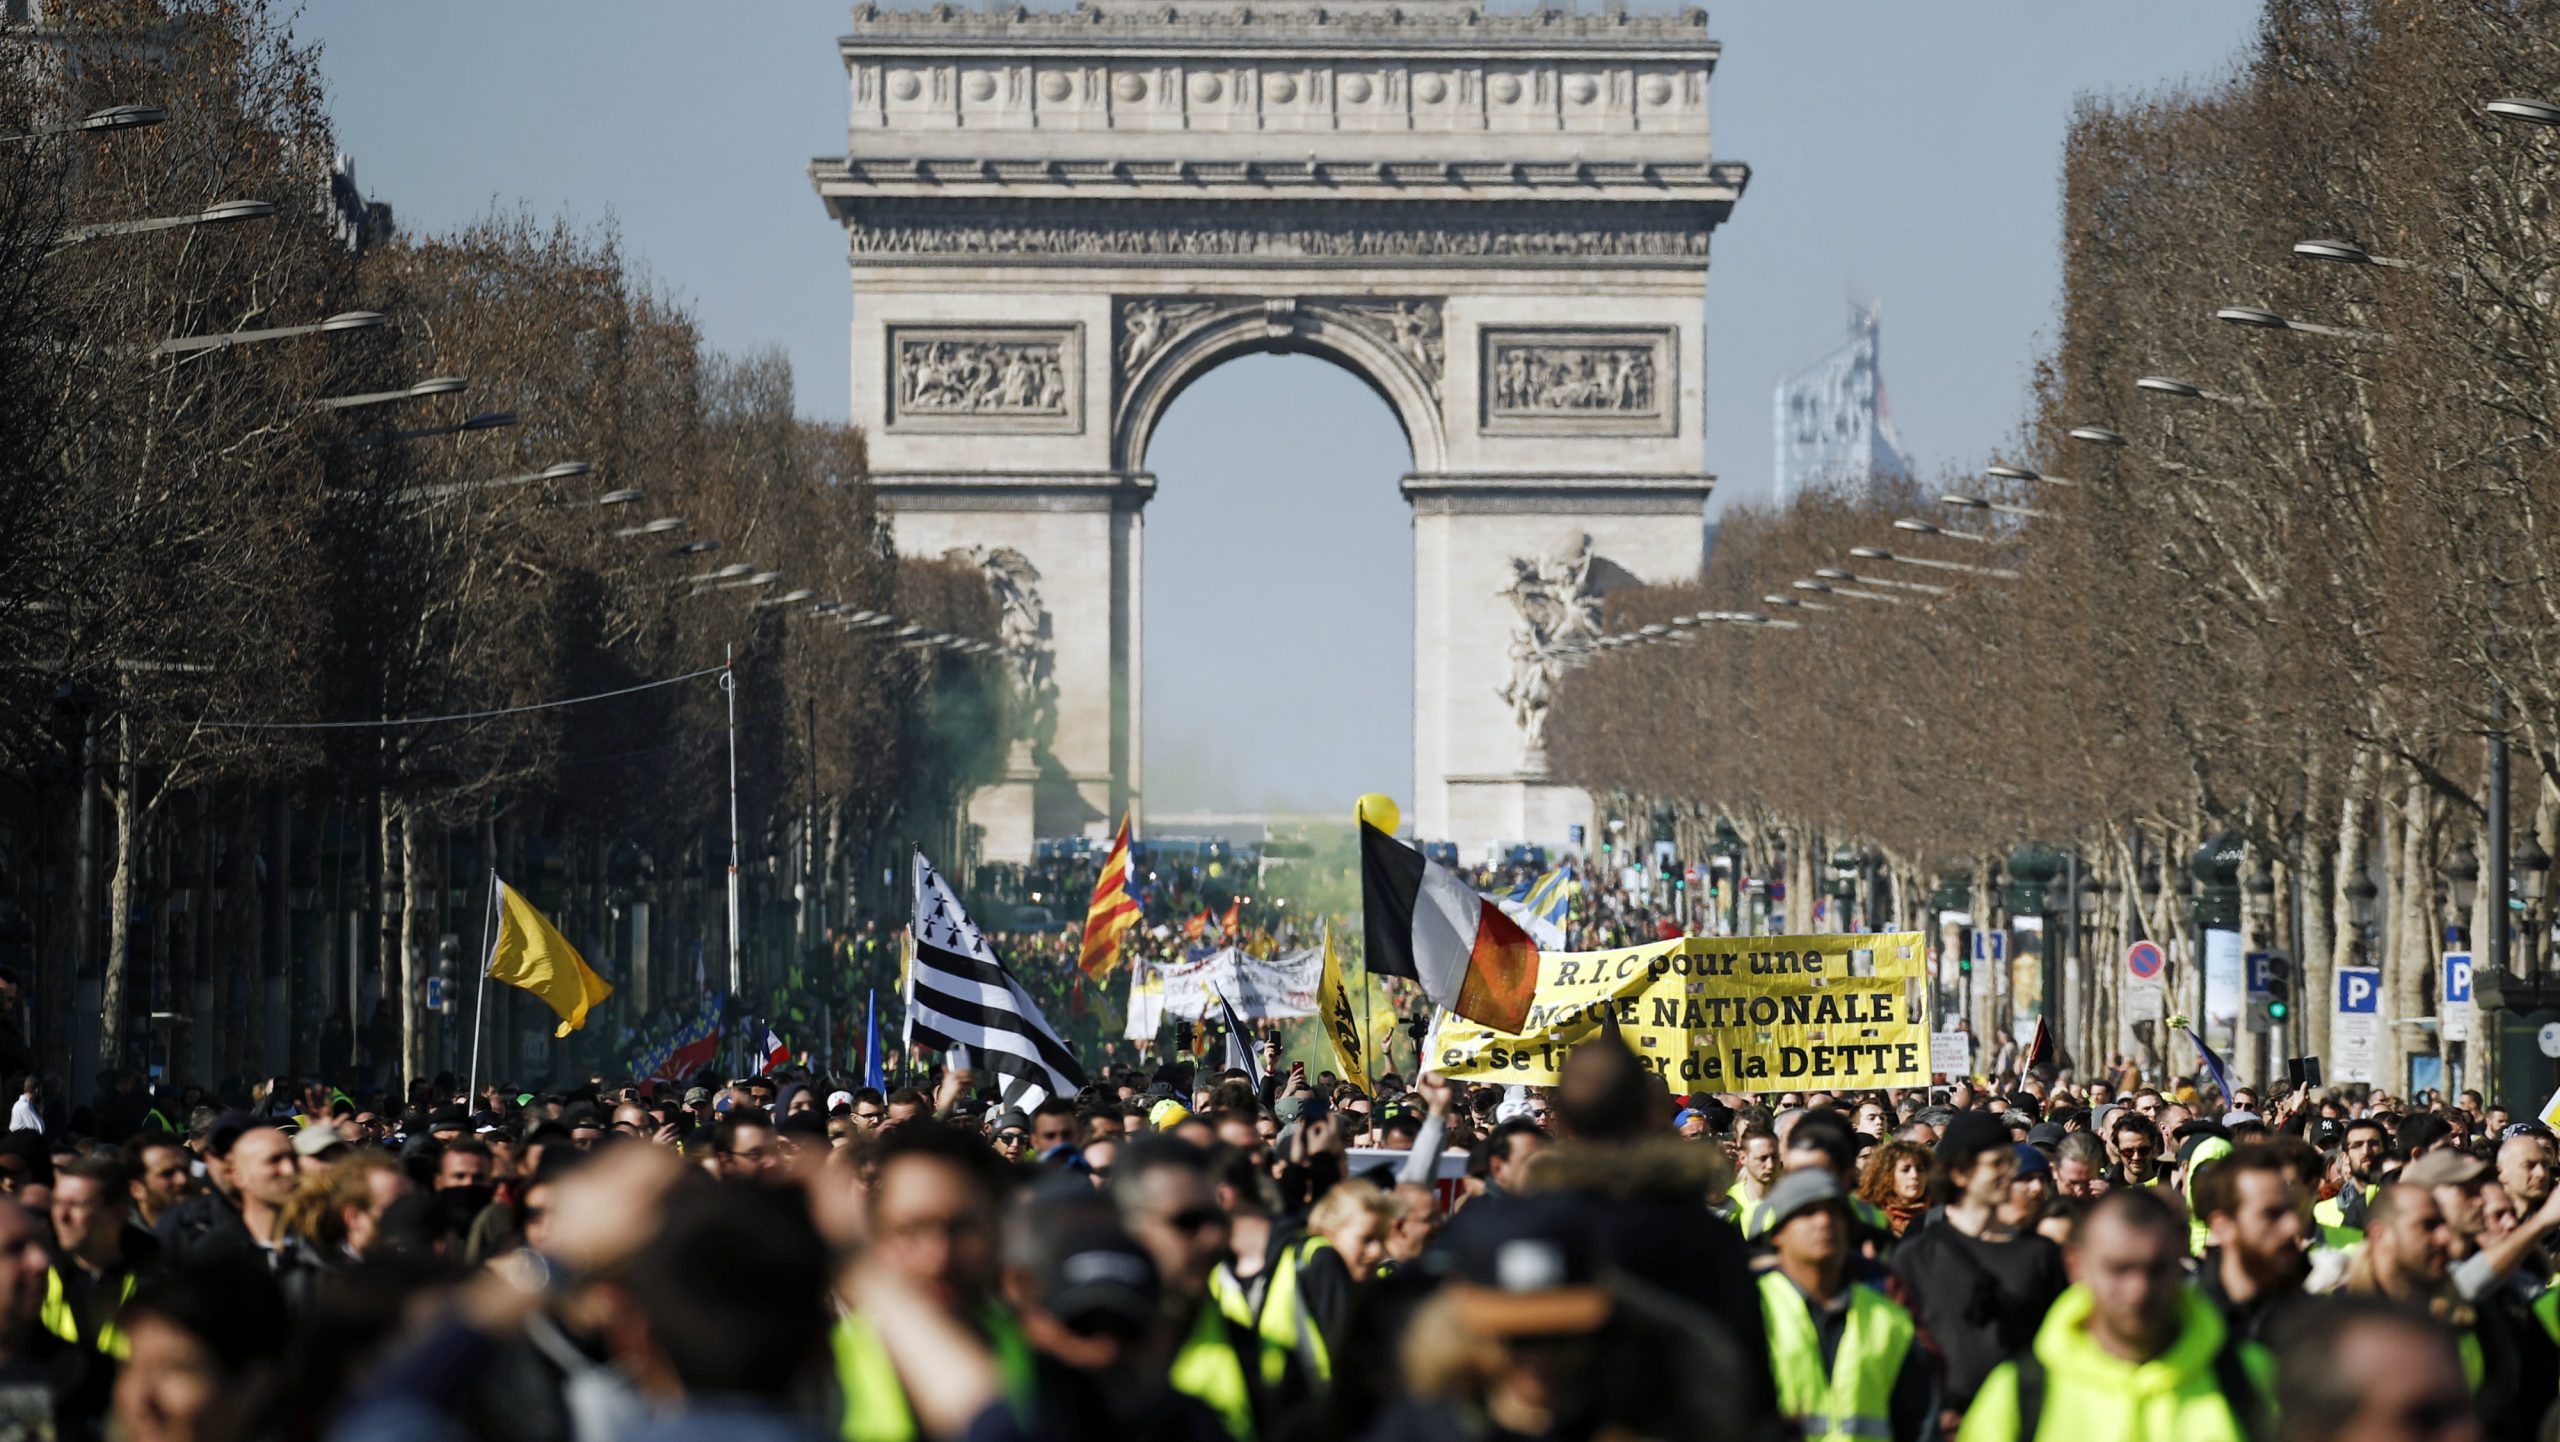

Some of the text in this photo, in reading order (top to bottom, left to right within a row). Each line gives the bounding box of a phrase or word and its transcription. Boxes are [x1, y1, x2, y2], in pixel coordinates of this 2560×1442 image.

[1554, 949, 1824, 987] R.I.C pour une
[2453, 961, 2473, 997] P
[2347, 975, 2371, 1008] P
[1651, 992, 1895, 1029] NATIONALE
[1489, 1047, 1532, 1071] se
[1539, 1043, 1671, 1080] lier
[1679, 1048, 1722, 1081] de
[1732, 1048, 1768, 1079] la
[1779, 1043, 1919, 1078] DETTE
